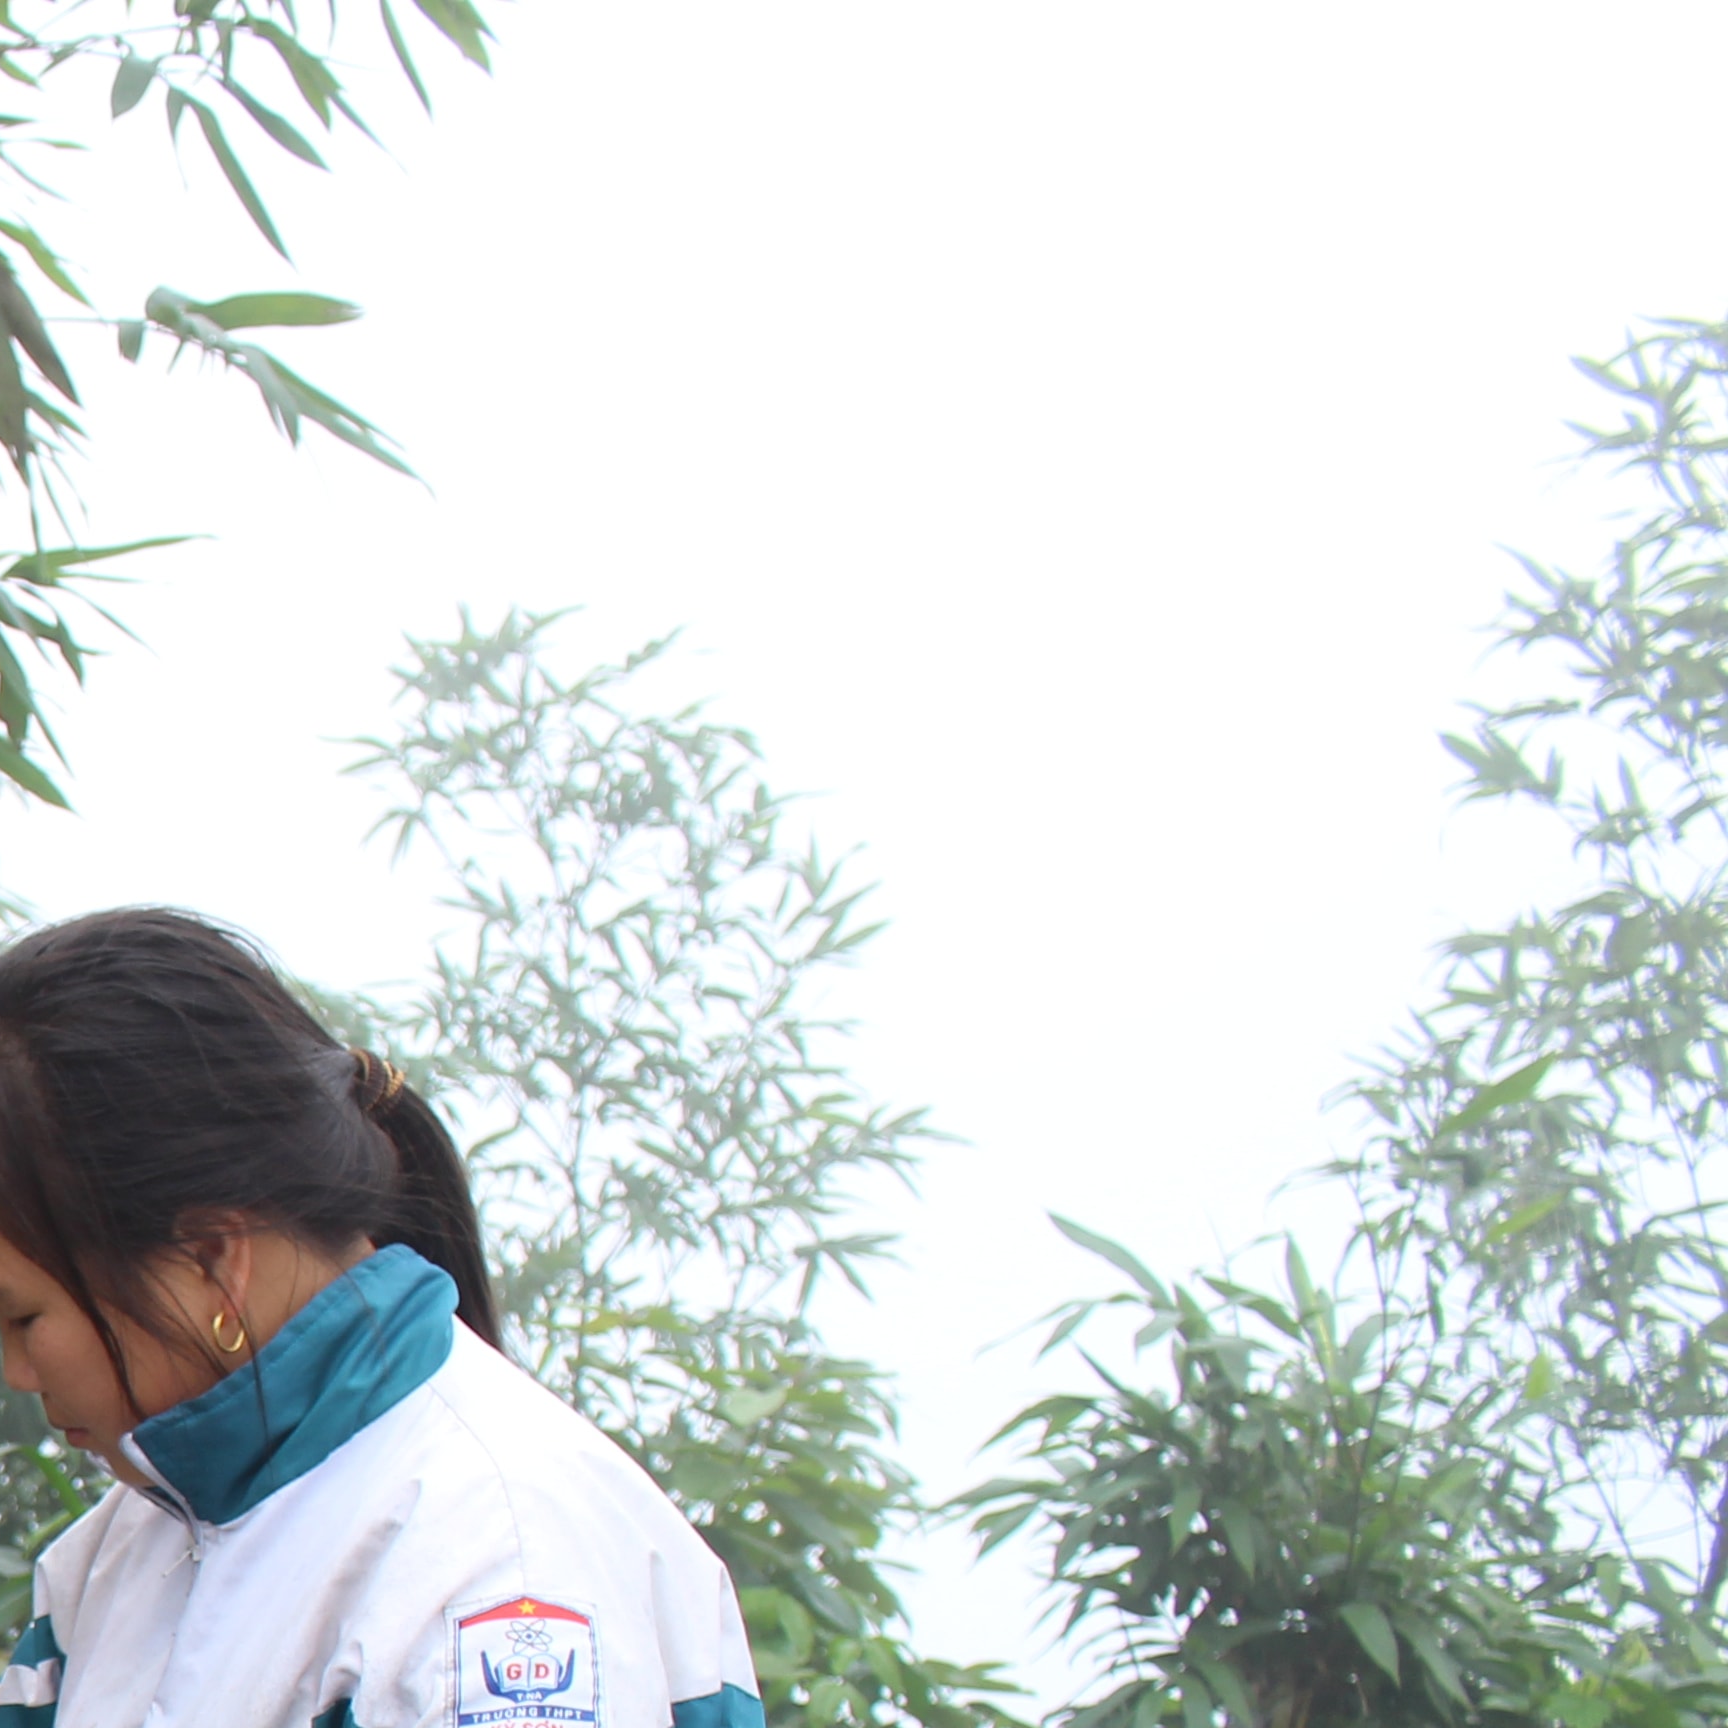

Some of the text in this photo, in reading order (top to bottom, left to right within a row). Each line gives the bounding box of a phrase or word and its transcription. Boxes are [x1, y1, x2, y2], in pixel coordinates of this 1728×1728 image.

[506, 1663, 549, 1681] G D
[545, 1707, 581, 1721] THPT
